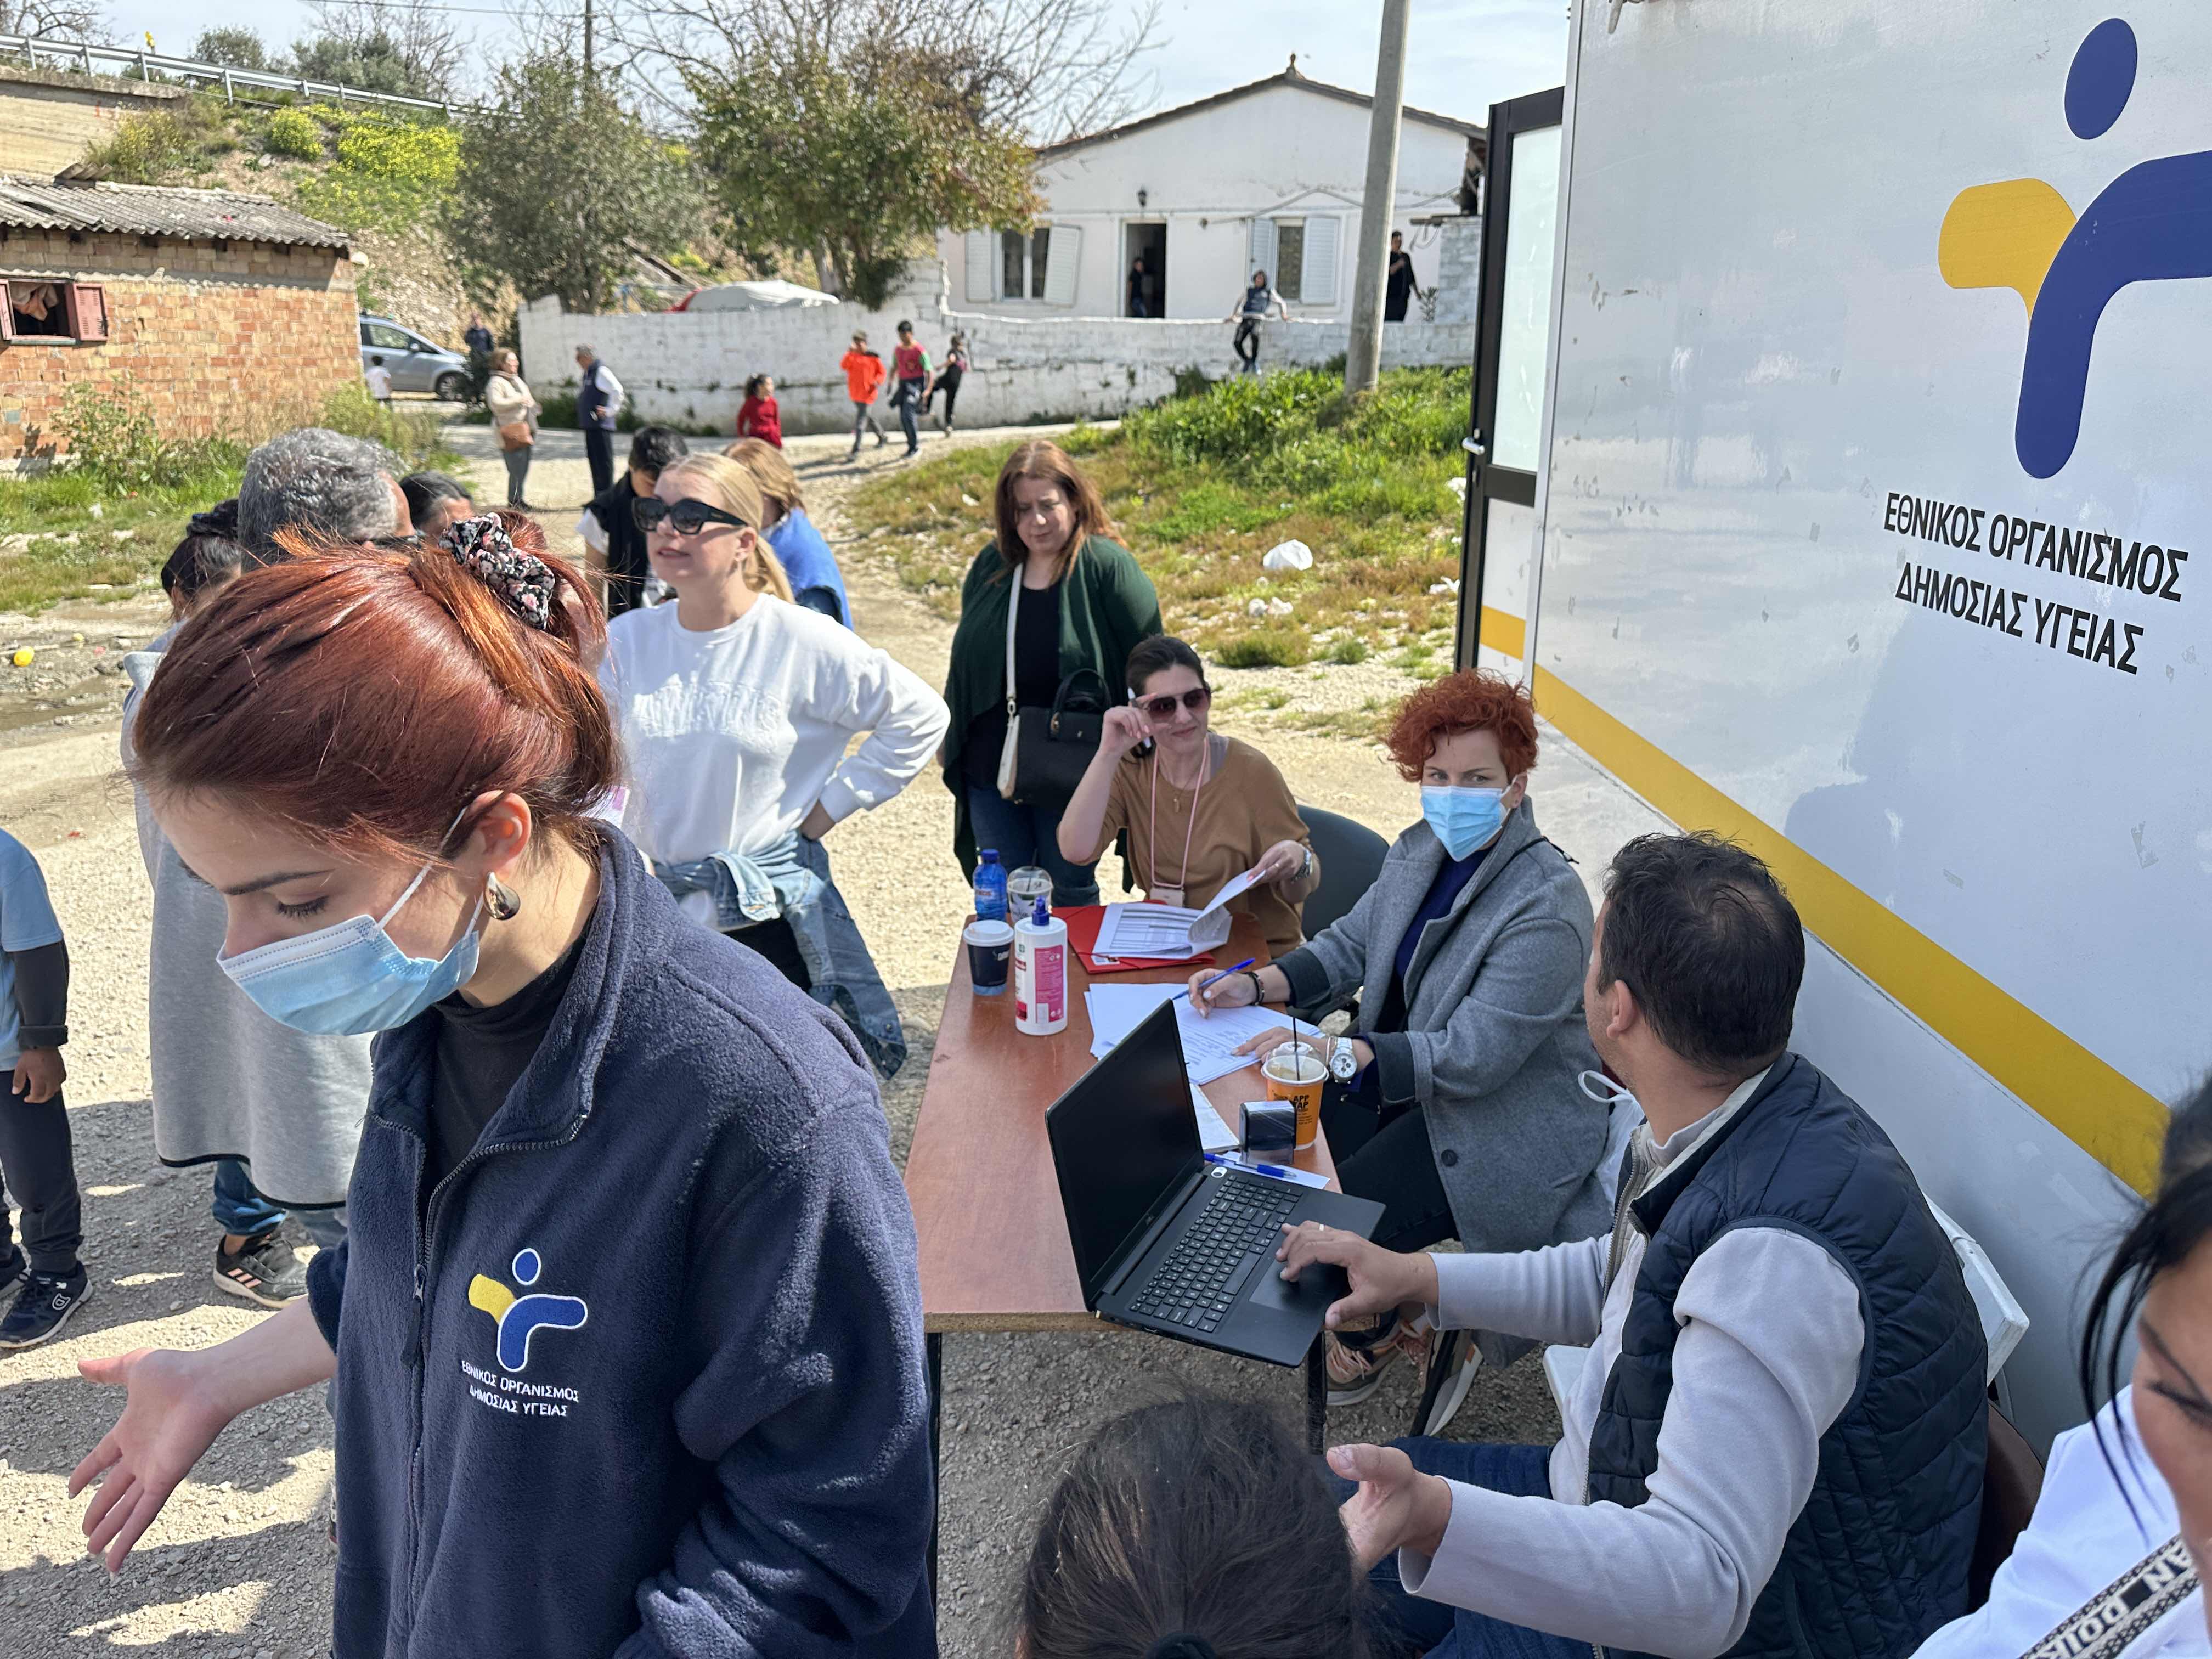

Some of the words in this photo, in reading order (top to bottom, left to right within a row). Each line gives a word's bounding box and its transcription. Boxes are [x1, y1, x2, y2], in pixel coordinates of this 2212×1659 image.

[1884, 492, 1985, 552] ΕΘΝΙΚΟΣ
[1989, 514, 2189, 602] ΟΡΓΑΝΙΣΜΟΣ
[1895, 562, 2028, 638] ΔΗΜΟΣΙΑΣ
[2035, 598, 2144, 675] ΥΓΕΙΑΣ
[461, 1360, 497, 1387] ΕΘΝΙΚΟΣ
[500, 1377, 579, 1403] ΟΡΓΑΝΙΣΜΟΣ
[469, 1384, 518, 1413] ΔΗΜΟΣΙΑΣ
[523, 1402, 568, 1417] ΥΓΕΙΑΣ
